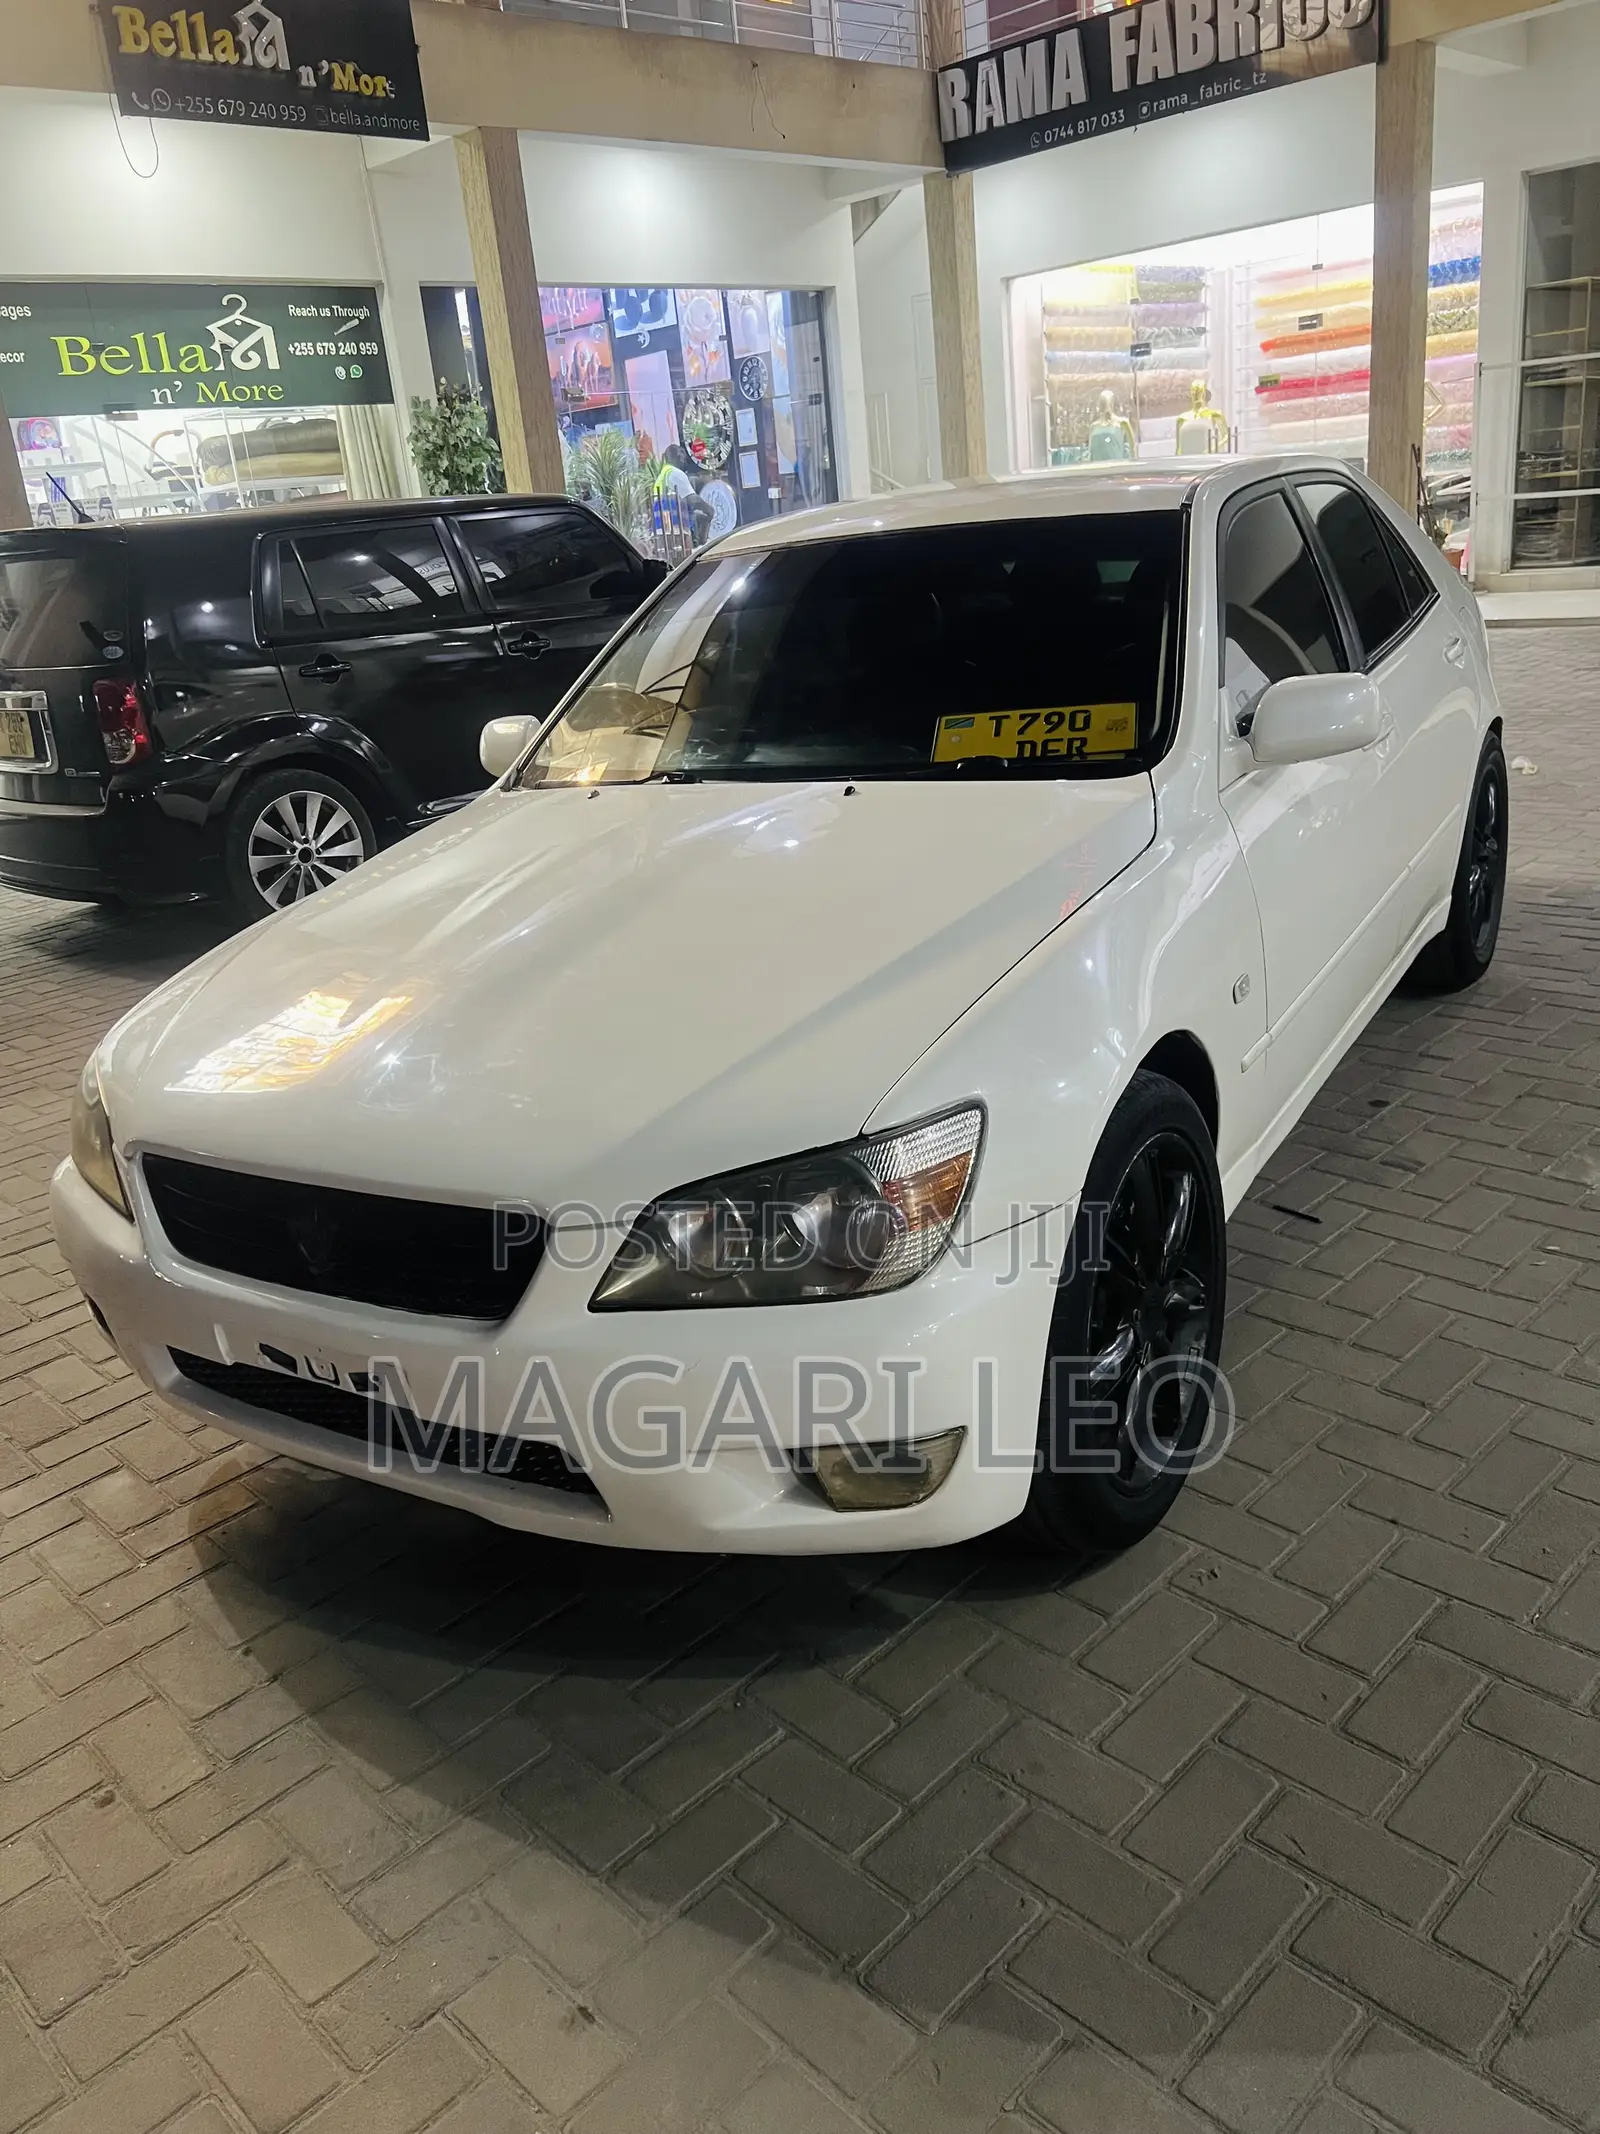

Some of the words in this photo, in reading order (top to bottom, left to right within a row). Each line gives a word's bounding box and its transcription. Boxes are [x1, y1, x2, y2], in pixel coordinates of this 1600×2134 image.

[112, 5, 239, 65] Bella
[938, 28, 1089, 142] RAMA
[175, 95, 214, 114] +255
[217, 99, 246, 117] 679
[249, 101, 277, 119] 240
[279, 104, 307, 122] 959
[330, 106, 420, 131] bella.andmore
[1044, 127, 1074, 144] 0744
[1077, 117, 1097, 134] 817
[1101, 109, 1125, 128] 033
[0, 305, 32, 320] ages
[288, 304, 318, 317] Reach
[319, 307, 331, 317] us
[331, 305, 371, 320] Through
[0, 352, 25, 363] ecor
[49, 331, 213, 376] Bella
[287, 342, 315, 356] +255
[316, 342, 336, 355] 679
[338, 342, 358, 355] 240
[359, 342, 379, 355] 959
[197, 381, 285, 403] More
